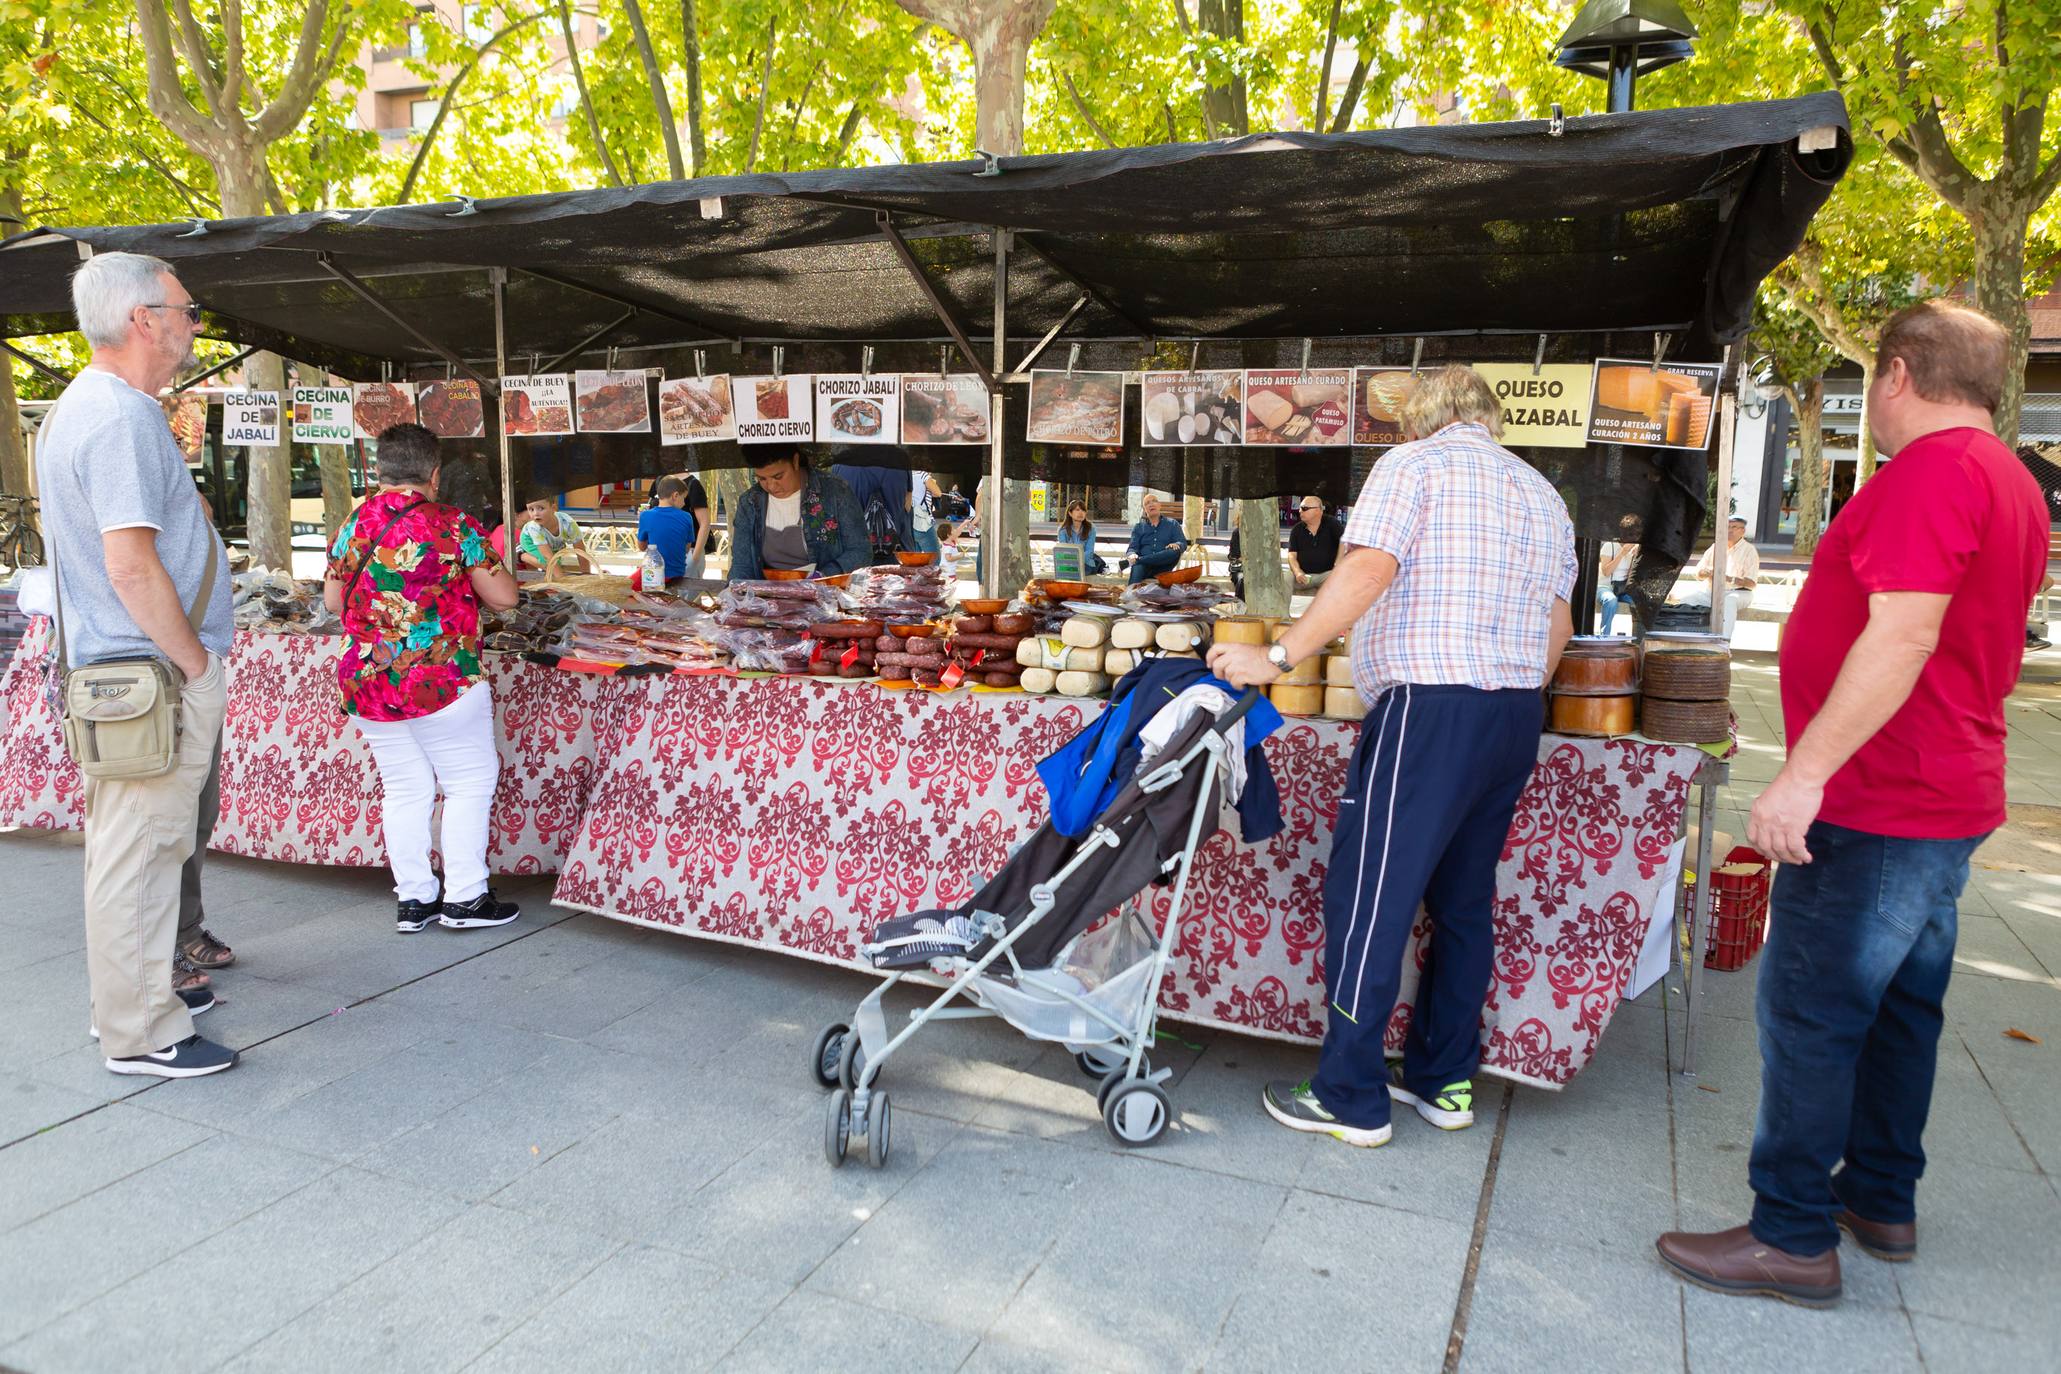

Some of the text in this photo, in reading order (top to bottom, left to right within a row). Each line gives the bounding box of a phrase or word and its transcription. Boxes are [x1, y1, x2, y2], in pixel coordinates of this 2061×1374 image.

[469, 381, 479, 389] DE
[504, 377, 564, 387] CECINA DE BUEY
[1178, 375, 1222, 383] ARTESANOS
[1249, 376, 1346, 386] QUESO ARTESANO CURADO
[819, 377, 896, 395] CHORIZO JABALÍ
[905, 381, 945, 391] CHORIZO
[946, 382, 958, 391] DE
[1495, 380, 1564, 400] QUESO
[226, 394, 277, 406] CECINA
[295, 390, 350, 403] CECINA
[241, 411, 259, 423] DE
[313, 408, 333, 420] DE
[738, 421, 811, 438] CHORIZO CIERVO
[1594, 418, 1662, 430] QUESO ARTESANO
[227, 427, 275, 440] JABALÍ
[295, 424, 351, 439] CIERVO
[691, 430, 719, 439] BUEY
[1355, 432, 1393, 443] QUESO
[1591, 429, 1630, 439] CURACIÓN
[1639, 431, 1662, 441] AÑOS
